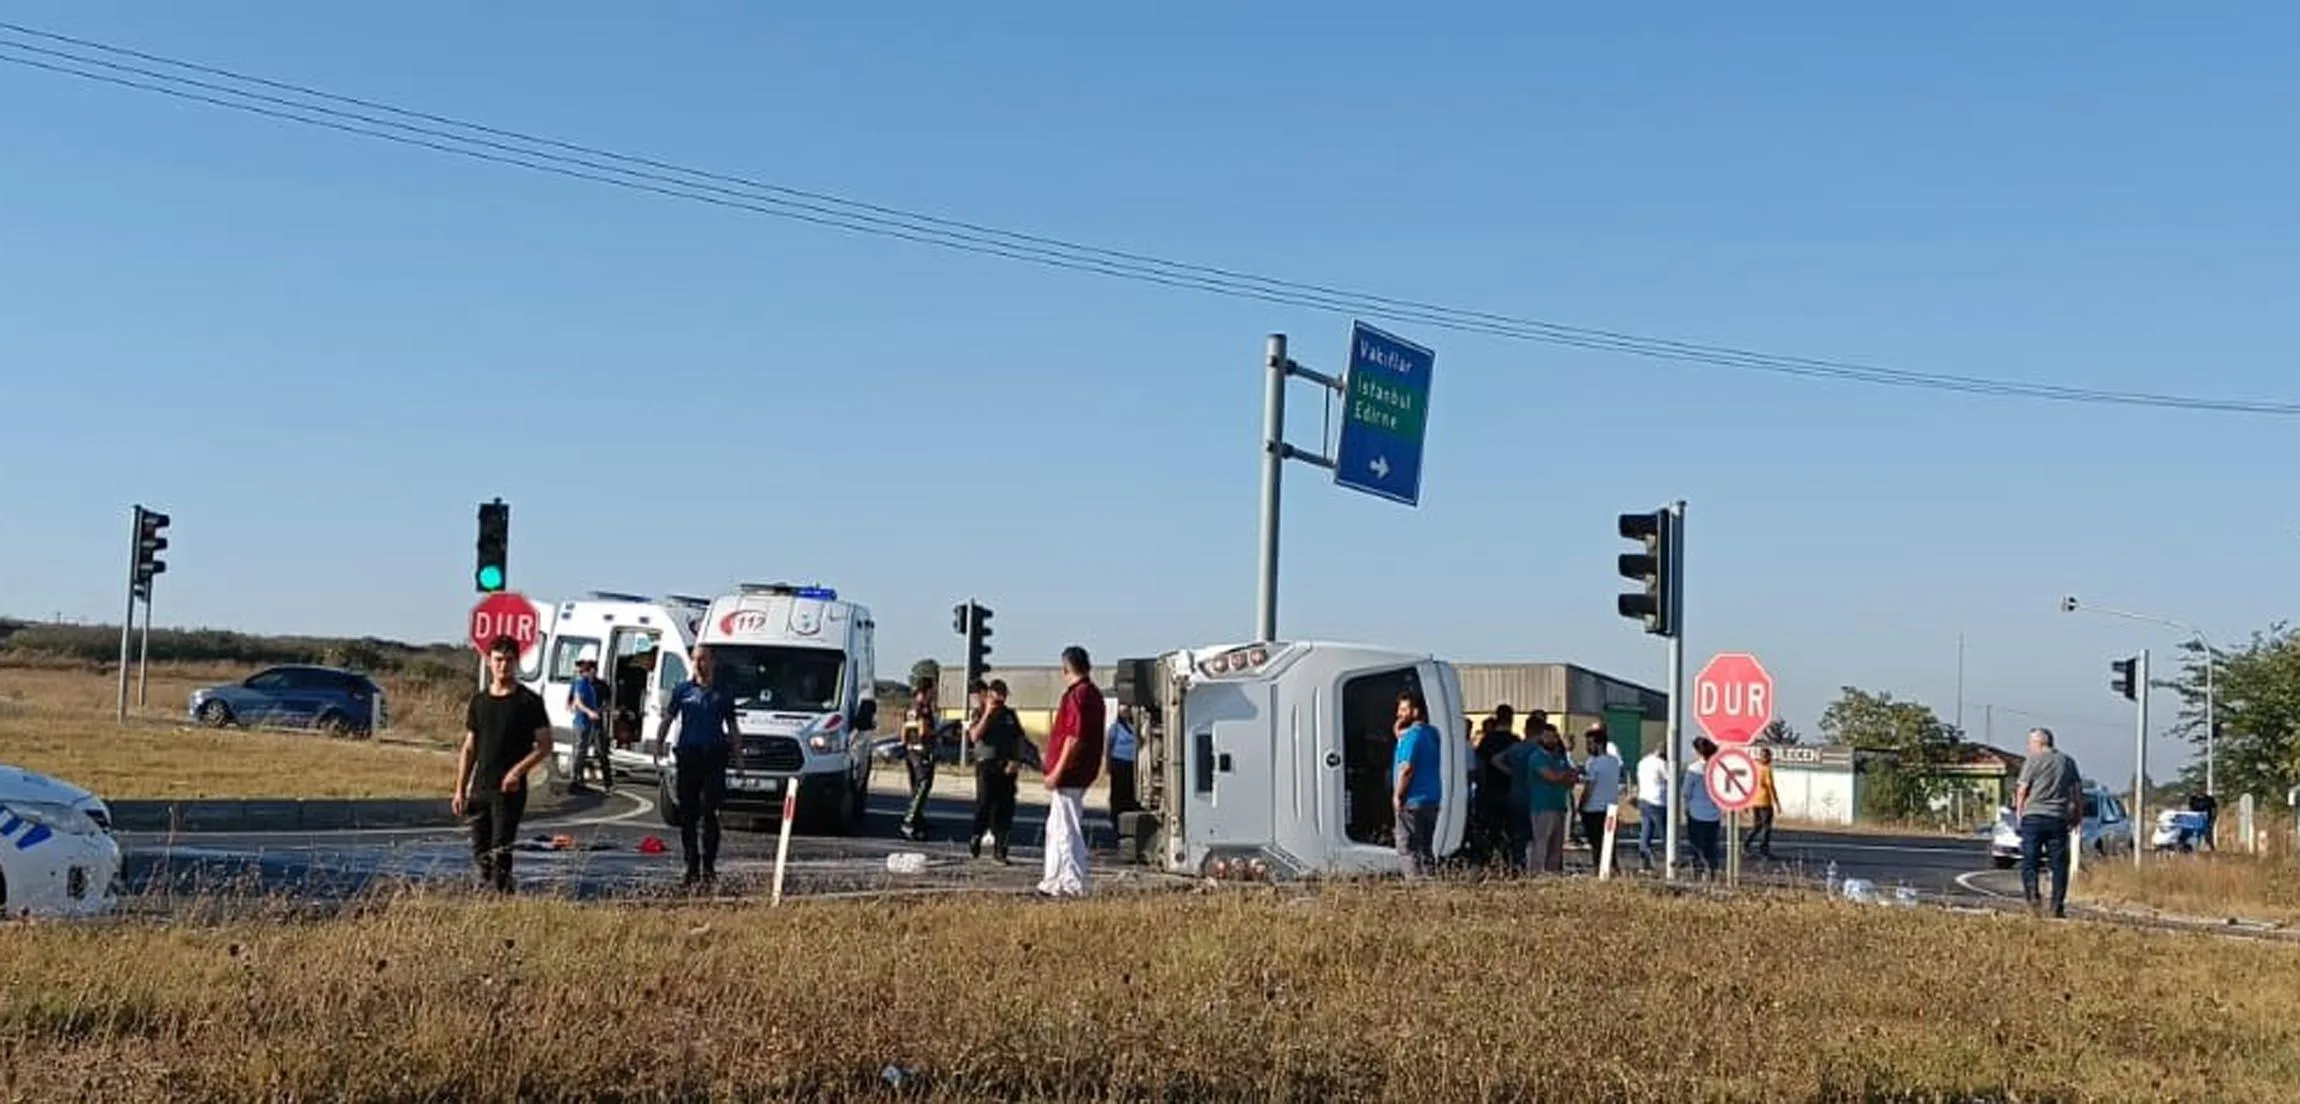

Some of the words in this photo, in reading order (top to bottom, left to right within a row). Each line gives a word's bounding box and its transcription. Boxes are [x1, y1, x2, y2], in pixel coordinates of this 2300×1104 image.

[1360, 338, 1412, 373] Vakıflar
[1354, 400, 1397, 430] Edirne
[475, 611, 533, 641] DUR
[738, 615, 766, 632] 112
[1700, 680, 1766, 718] DUR
